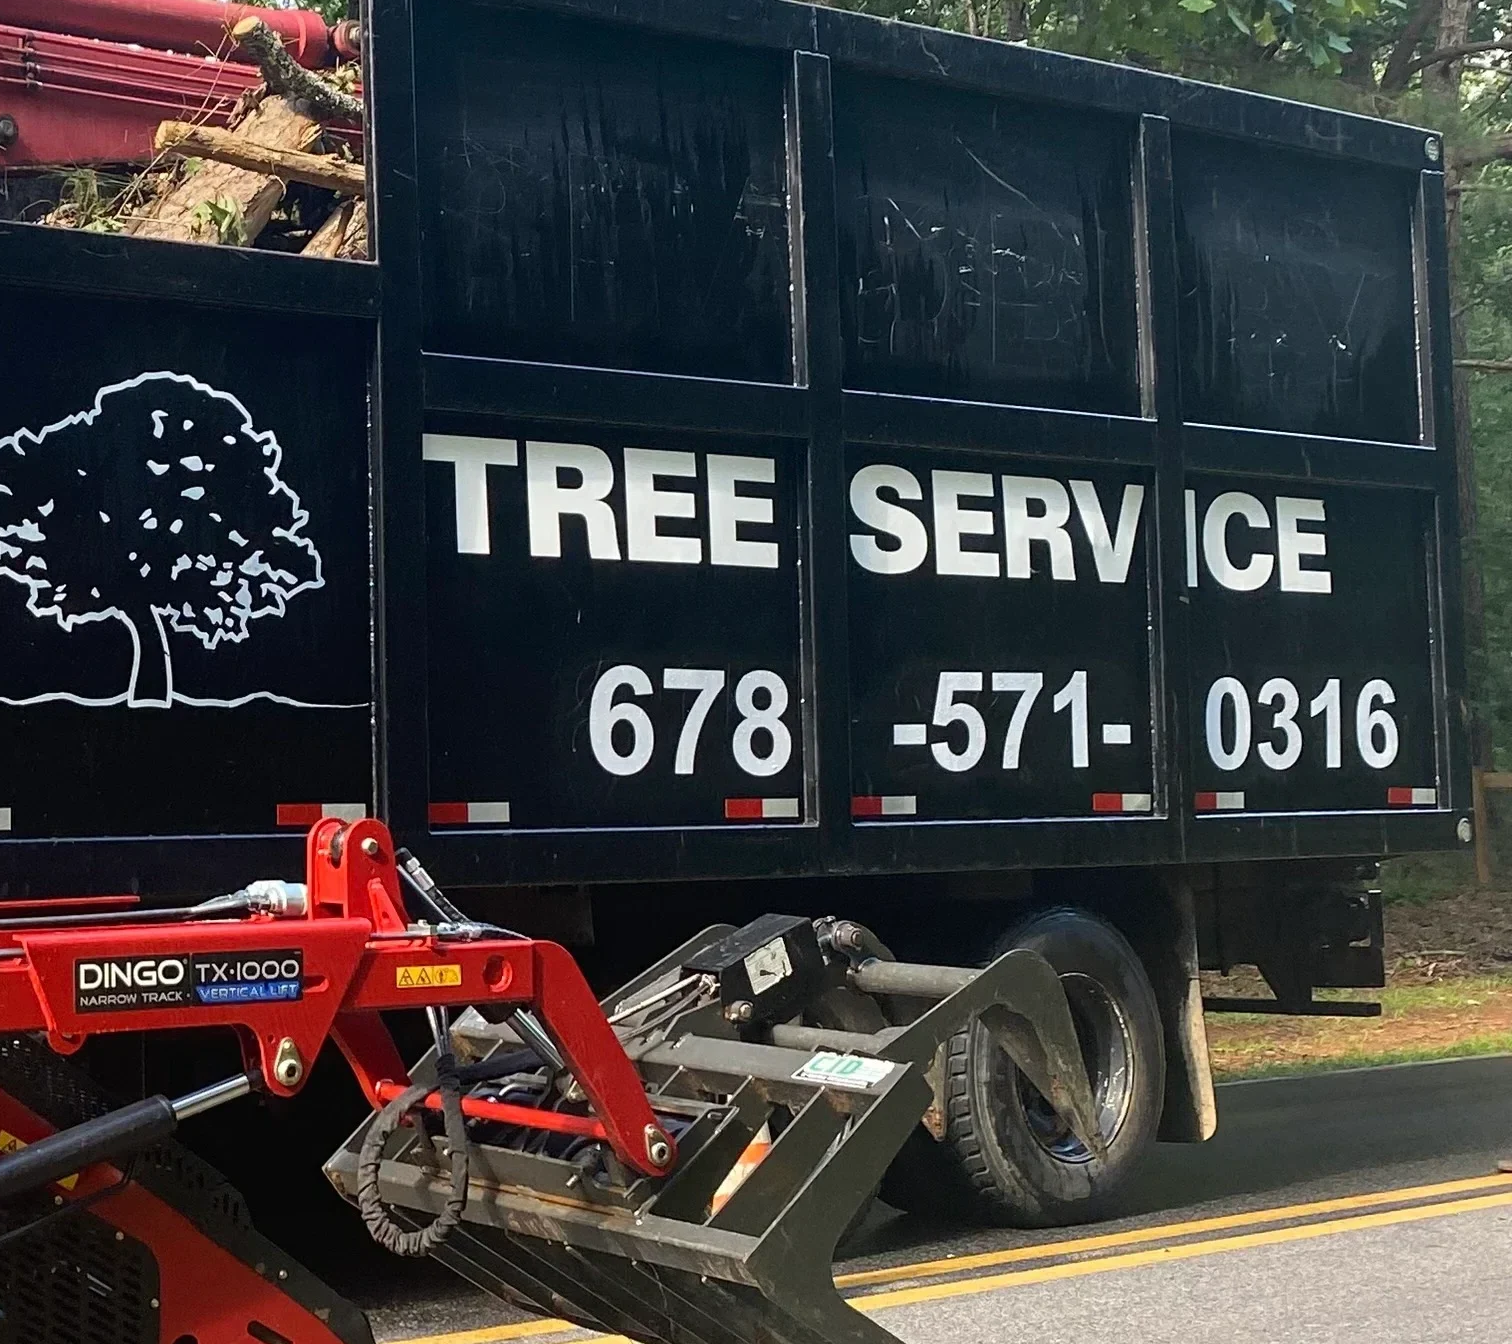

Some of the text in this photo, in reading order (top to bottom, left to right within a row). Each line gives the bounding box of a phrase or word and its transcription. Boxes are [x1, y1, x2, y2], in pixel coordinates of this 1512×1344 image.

[422, 433, 779, 569] TREE
[589, 665, 792, 777] 678
[1205, 676, 1399, 771] 0316
[79, 959, 185, 990] DINGO
[80, 991, 183, 1007] NARROW TRACK
[200, 983, 298, 1000] VERTICAL LIFT
